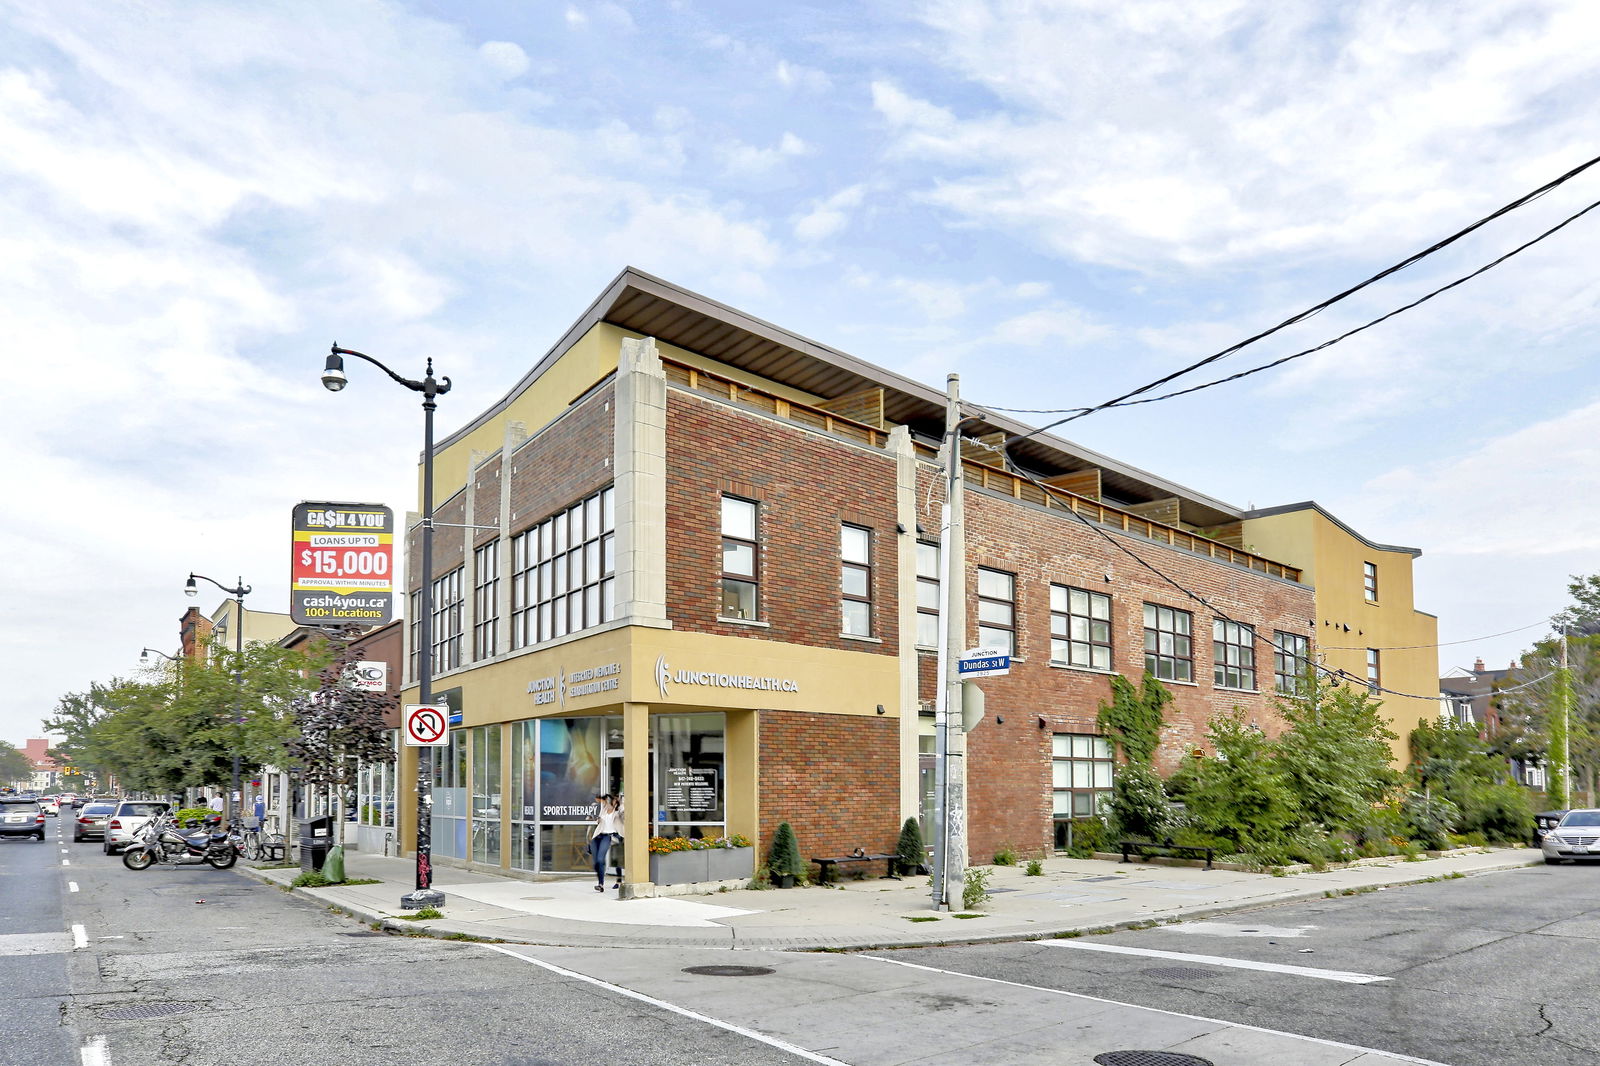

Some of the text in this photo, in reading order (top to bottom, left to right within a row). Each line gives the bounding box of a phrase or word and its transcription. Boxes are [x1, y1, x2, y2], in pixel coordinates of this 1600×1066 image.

[307, 509, 384, 528] CA$H 4 YOU
[314, 537, 376, 545] LOANS UP TO
[301, 549, 388, 576] $15,000
[335, 579, 357, 587] WITHIN
[303, 595, 385, 611] cash4you.ca
[305, 608, 382, 618] 100+ Locations
[963, 661, 990, 670] Dundas
[998, 658, 1005, 667] W
[527, 676, 556, 694] JUNCTION
[601, 678, 619, 692] CENTRE
[674, 670, 798, 692] JUNCTIONHEALTH.CA
[534, 691, 556, 705] HEALTH
[543, 805, 567, 816] SPORTS
[568, 805, 598, 816] THERAPY
